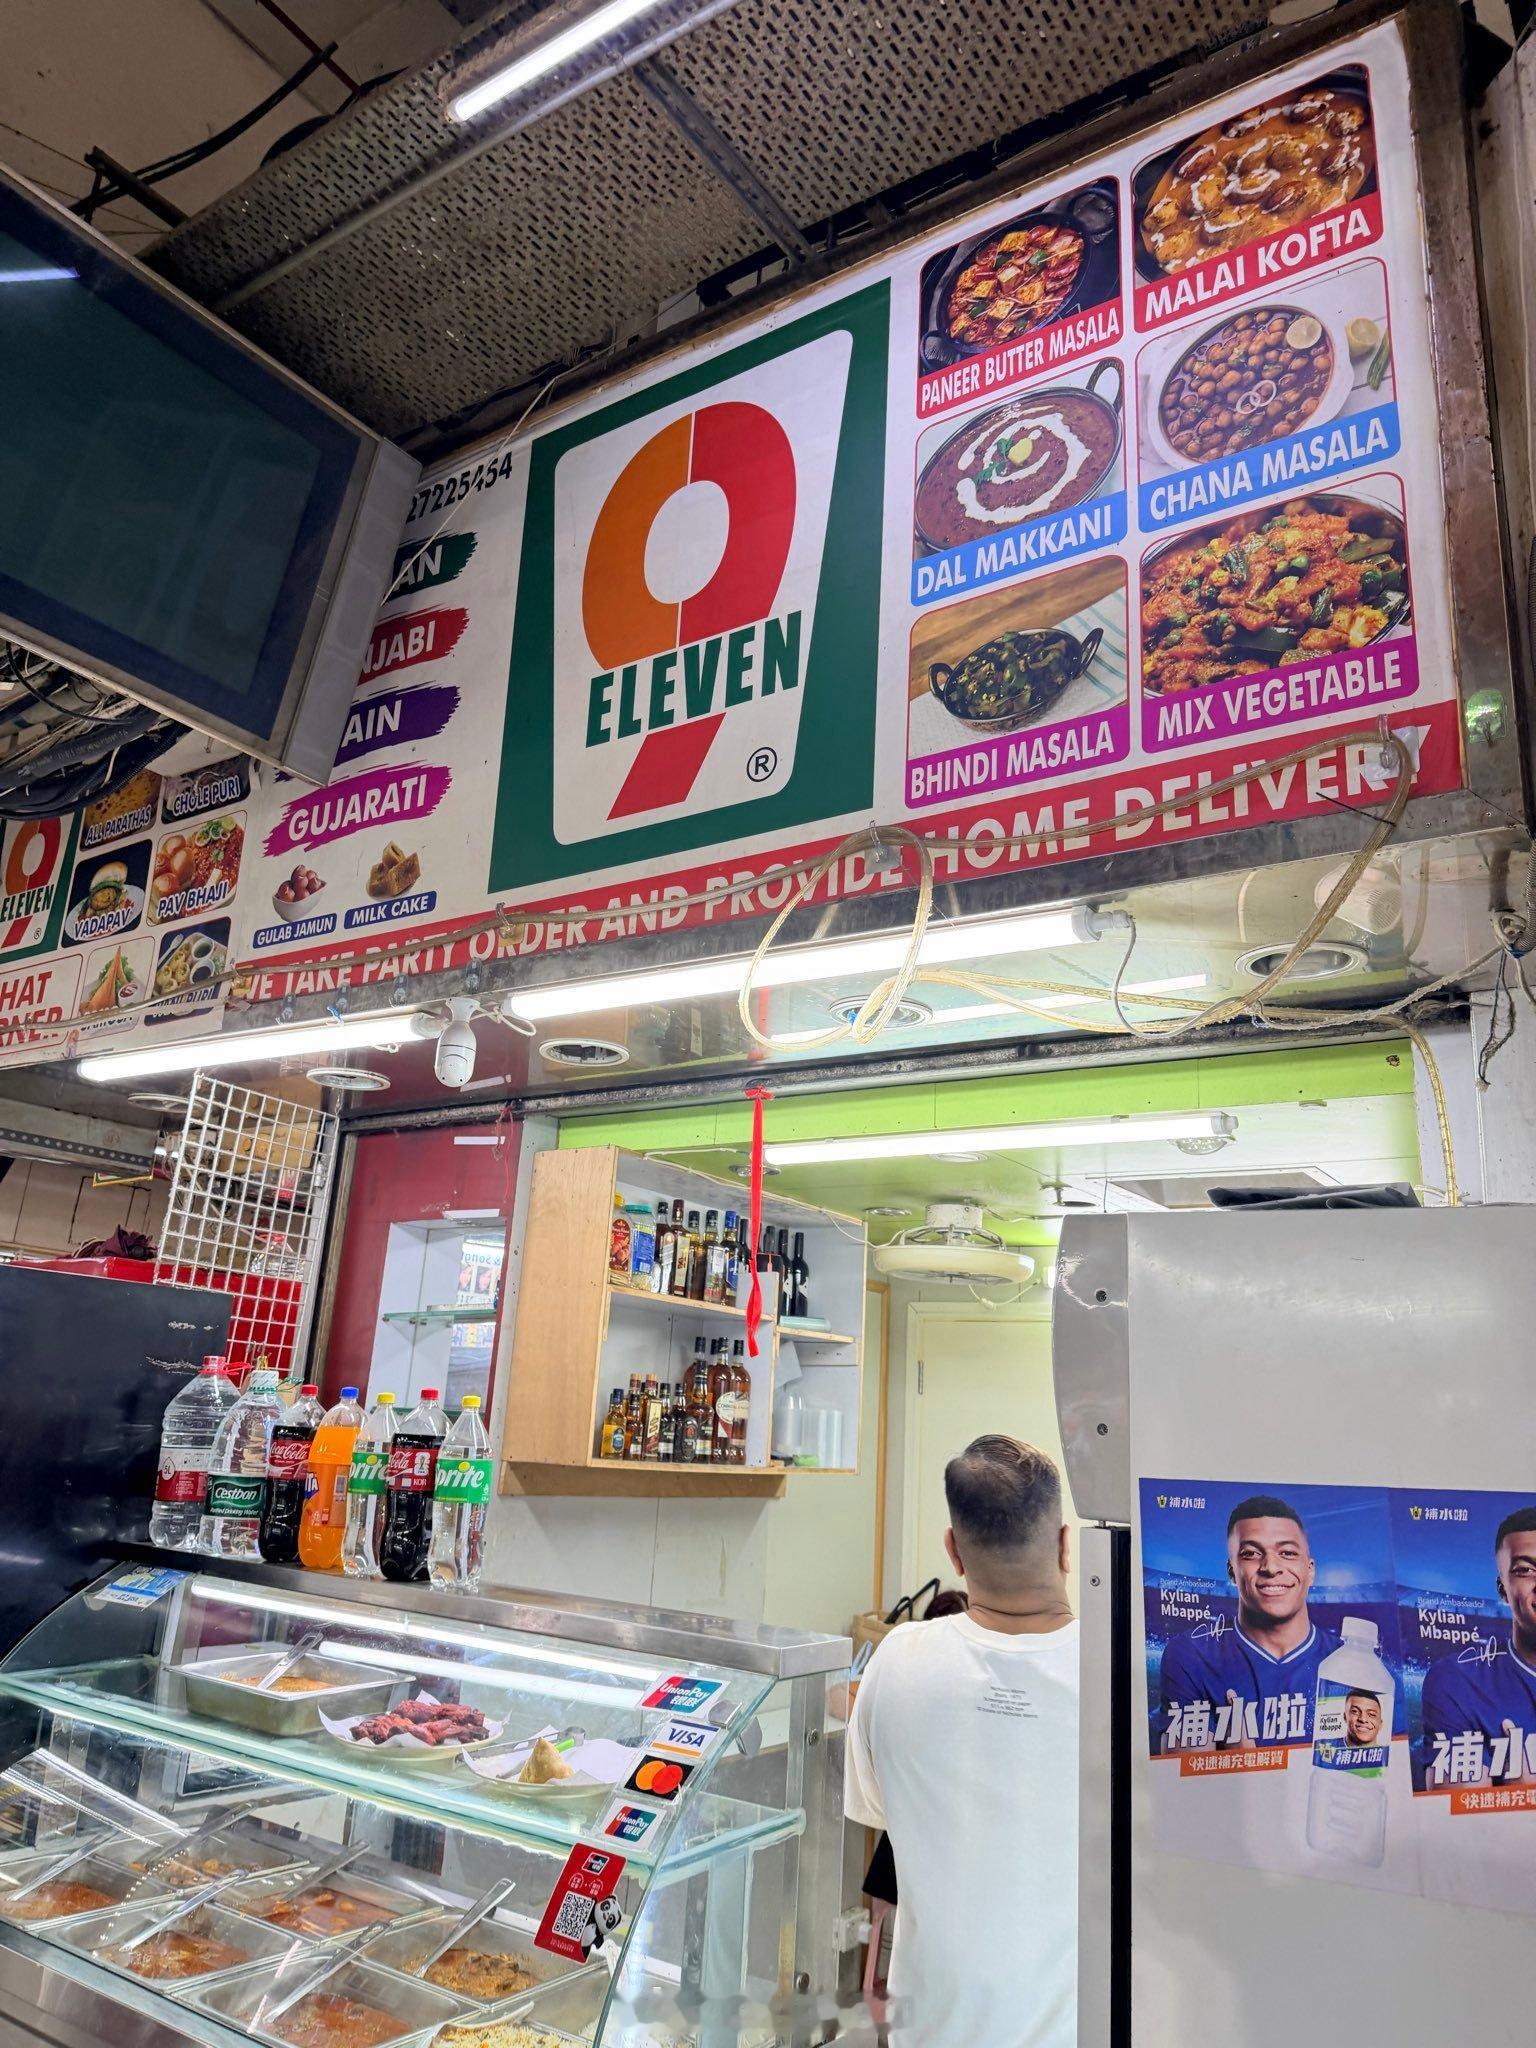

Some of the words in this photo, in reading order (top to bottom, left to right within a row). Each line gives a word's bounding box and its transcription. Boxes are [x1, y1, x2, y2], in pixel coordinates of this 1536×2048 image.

[1144, 262, 1246, 322] MALAI
[1257, 207, 1371, 279] KOFTA
[921, 363, 981, 413] PANEER
[985, 345, 1044, 385] BUTTER
[1047, 308, 1121, 359] MASALA
[406, 451, 512, 524] 27225454
[1149, 466, 1252, 522] CHANA
[1261, 414, 1390, 488] MASALA
[393, 543, 443, 593] AN
[916, 557, 968, 598] DAL
[974, 504, 1113, 569] MAKKANI
[361, 620, 436, 674] NJABI
[586, 610, 801, 748] ELEVEN
[1157, 694, 1213, 742] MIX
[1222, 650, 1402, 722] VEGETABLE
[340, 699, 402, 748] AIN
[910, 752, 998, 801] BHINDI
[1006, 719, 1114, 776] MASALA
[173, 787, 211, 817] CHOLE
[210, 776, 241, 805] PURI
[287, 774, 427, 843] GUJARATI
[84, 825, 104, 846] ALL
[103, 805, 152, 838] PARATHAS
[0, 884, 55, 922] ELEVEN
[157, 891, 186, 919] PAV
[186, 880, 230, 909] BHAJI
[284, 951, 357, 995] TAKE
[362, 930, 464, 983] PARTY
[597, 885, 689, 941] AND
[926, 797, 1090, 876] HOME
[352, 903, 387, 926] MILK
[390, 896, 429, 917] CAKE
[74, 908, 131, 941] VADAPAV
[257, 924, 292, 946] GULAB
[292, 917, 333, 942] JAMUN
[0, 970, 53, 1012] HAT
[349, 1459, 389, 1481] prite
[1160, 1589, 1200, 1604] Kylian
[1161, 1604, 1211, 1621] Mbappé
[1418, 1608, 1466, 1625] Kylian
[1420, 1625, 1480, 1644] Mbappé
[659, 1682, 710, 1700] UnionPay
[668, 1727, 706, 1748] VISA
[1165, 1693, 1307, 1749] 補水啦
[1335, 1748, 1384, 1765] 補水啦
[616, 1812, 650, 1831] UnionPay
